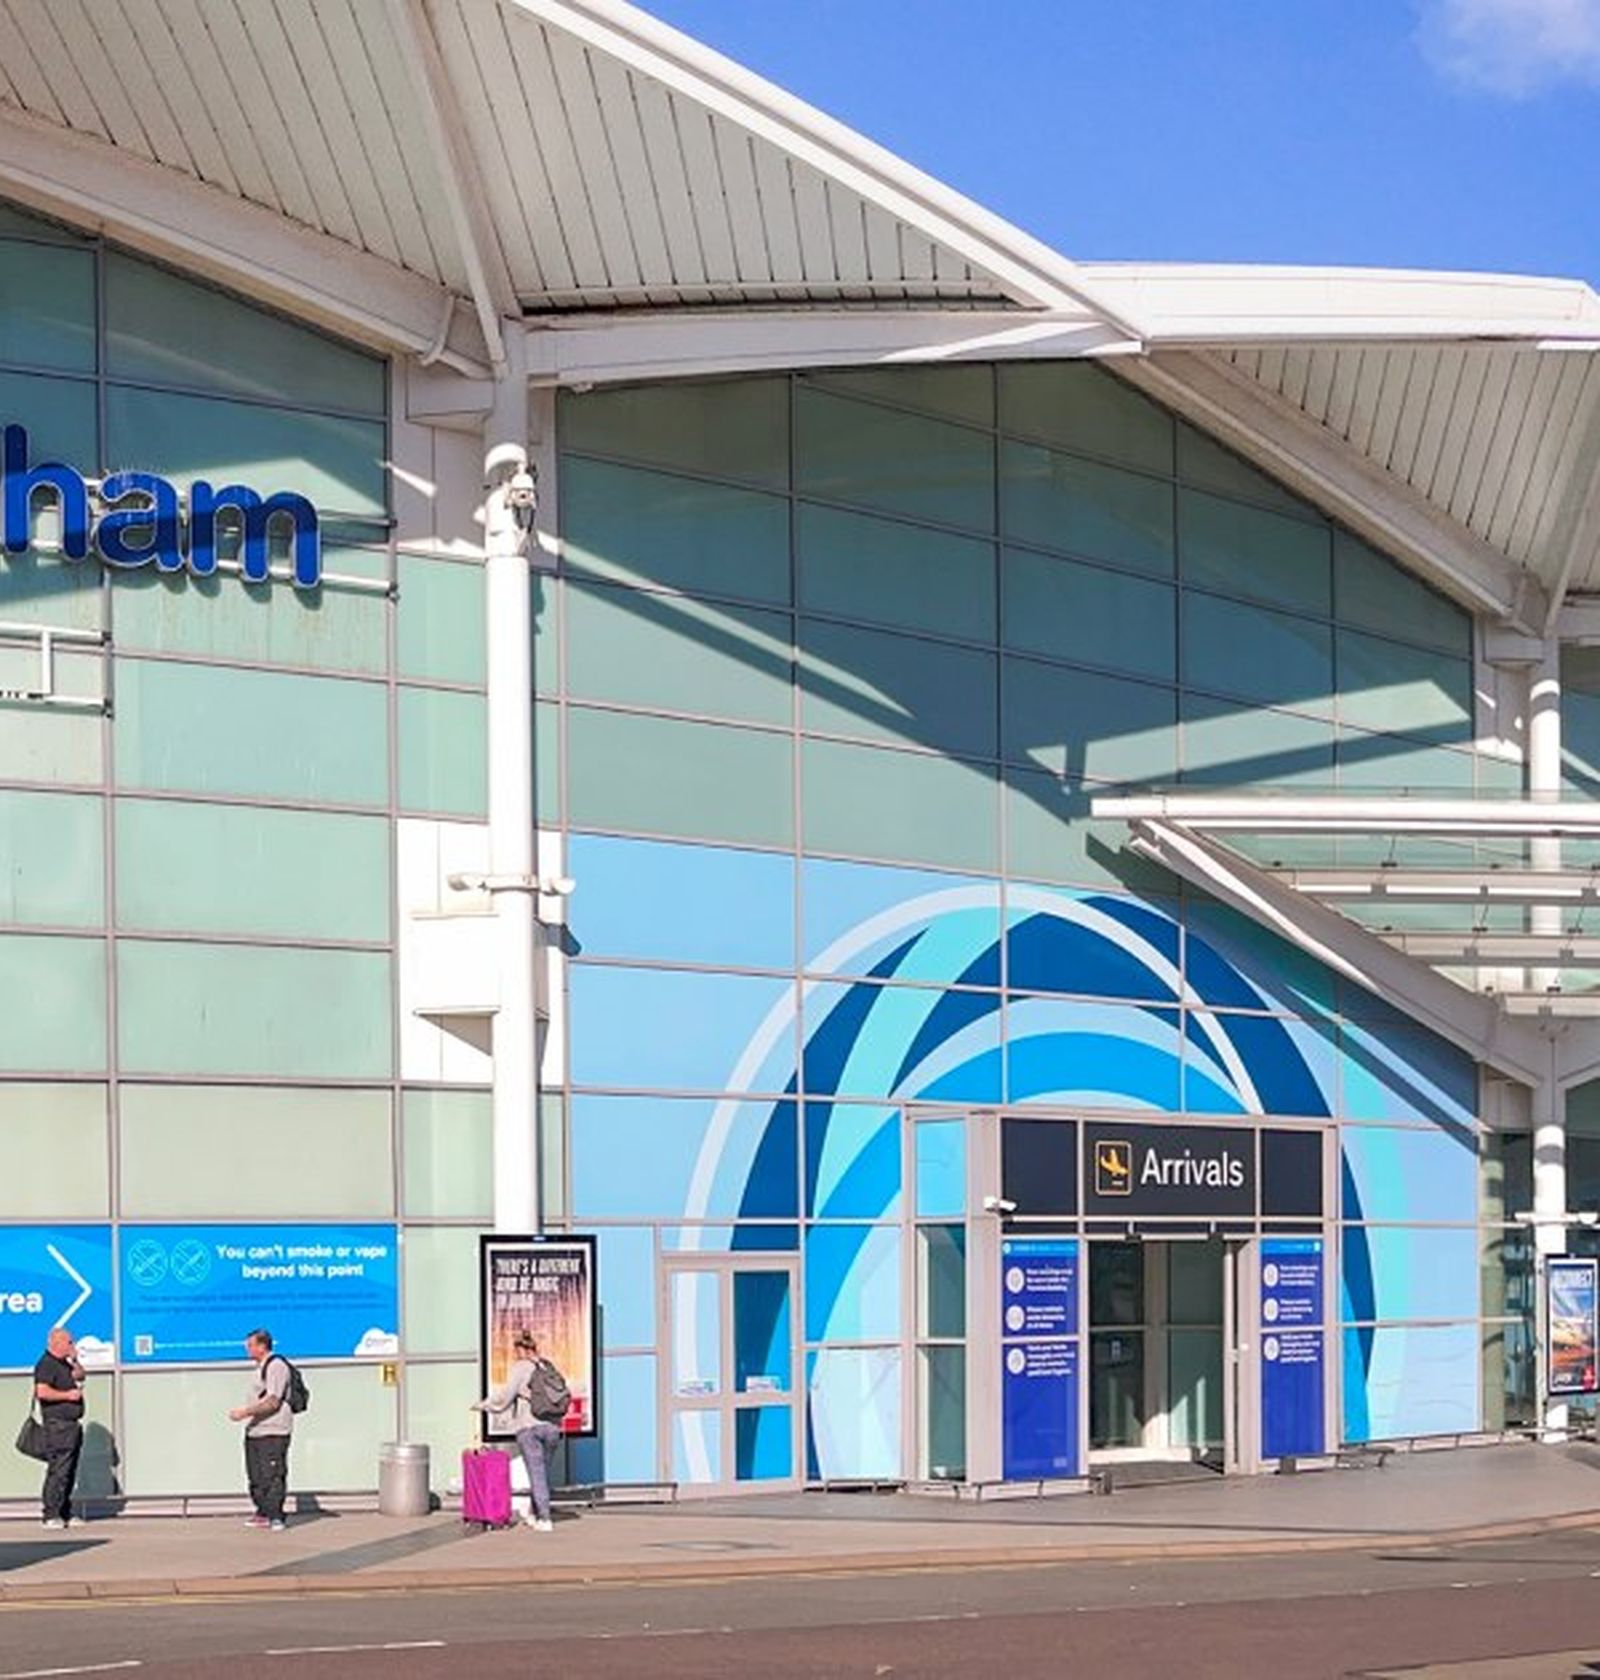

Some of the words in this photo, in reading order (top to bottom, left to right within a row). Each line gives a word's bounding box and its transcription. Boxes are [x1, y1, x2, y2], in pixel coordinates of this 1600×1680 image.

[1139, 1147, 1245, 1188] Arrivals
[215, 1244, 246, 1259] You
[248, 1243, 284, 1259] can't
[287, 1243, 334, 1258] smoke
[336, 1247, 351, 1258] or
[354, 1246, 388, 1262] vape
[241, 1264, 296, 1280] beyond
[298, 1262, 325, 1277] this
[327, 1262, 364, 1280] point
